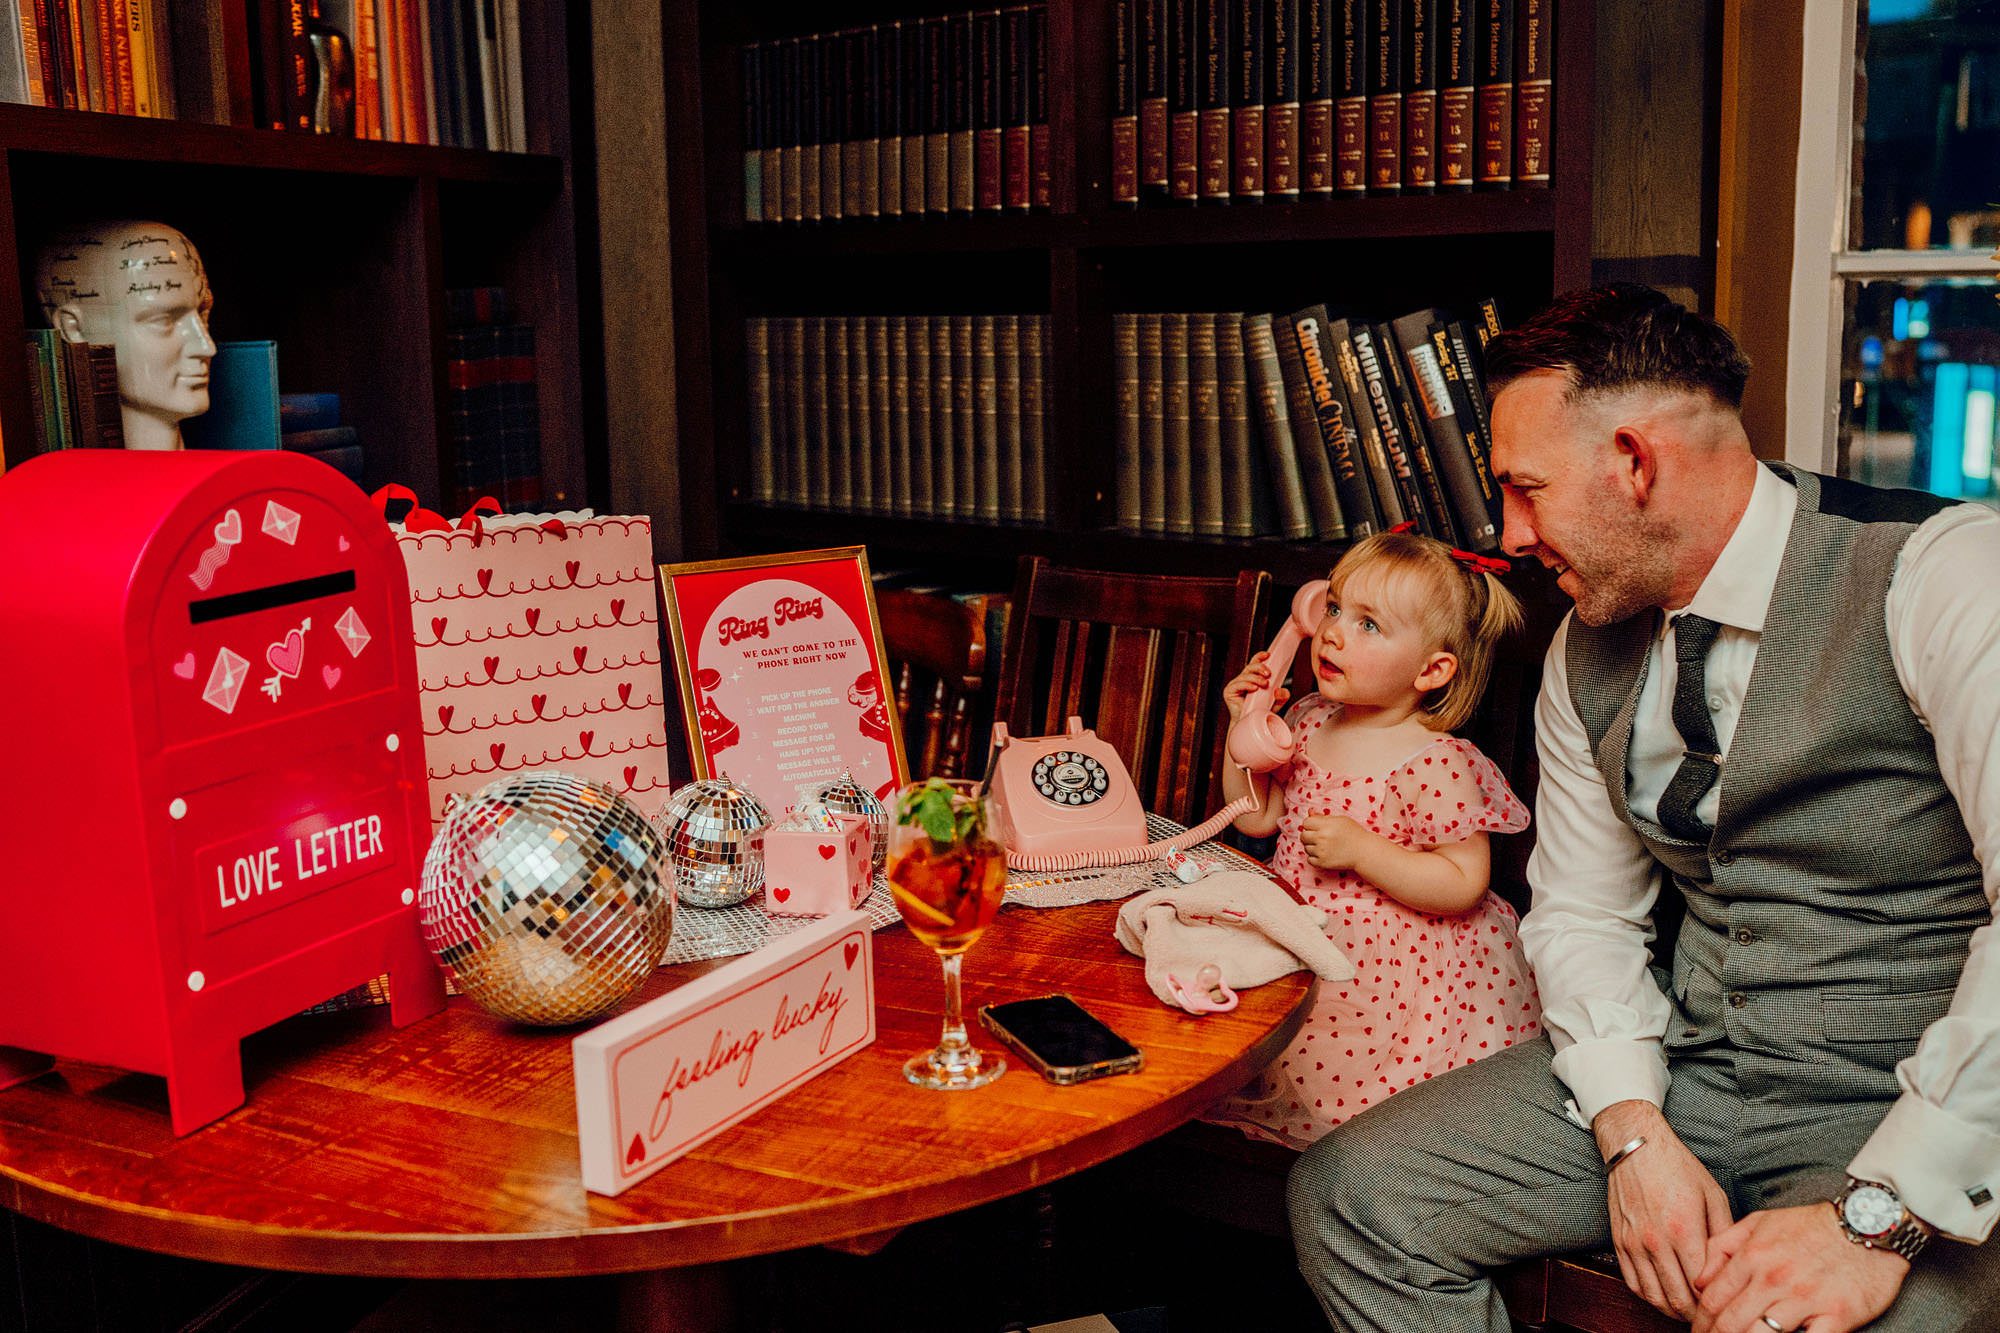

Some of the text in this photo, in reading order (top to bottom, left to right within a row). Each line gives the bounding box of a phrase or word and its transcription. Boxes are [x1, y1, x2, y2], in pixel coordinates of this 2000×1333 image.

[1450, 27, 1461, 81] Britannica
[1489, 22, 1500, 77] Britannica
[1527, 18, 1539, 74] Britannica
[1450, 124, 1461, 136] 15
[1488, 121, 1500, 132] 16
[1527, 118, 1538, 129] 17
[1344, 132, 1355, 144] 12
[1433, 330, 1451, 367] Boeing
[1452, 337, 1474, 381] AVIATION
[1296, 317, 1333, 403] Chronicle
[1318, 400, 1356, 481] CINEMA
[718, 596, 825, 647] Ring Ring
[742, 638, 858, 659] WE CAN'T COME TO THE
[757, 651, 847, 669] PHONE RIGHT NOW
[761, 694, 778, 703] PICK
[780, 692, 791, 700] UP
[792, 689, 806, 699] THE
[807, 686, 833, 697] PHONE
[756, 704, 776, 715] WAIT
[777, 703, 792, 712] FOR
[793, 701, 808, 710] THE
[809, 697, 840, 708] ANSWER
[783, 711, 817, 723] MACHINE
[777, 725, 808, 736] RECORD
[808, 721, 829, 731] YOUR
[772, 732, 836, 748] MESSAGE FOR US
[779, 749, 801, 759] HANG
[815, 744, 836, 753] YOUR
[776, 754, 842, 771] MESSAGE WILL BE
[783, 766, 841, 781] AUTOMATICALLY
[217, 814, 384, 909] LOVE LETTER
[649, 971, 849, 1143] feeling lucky
